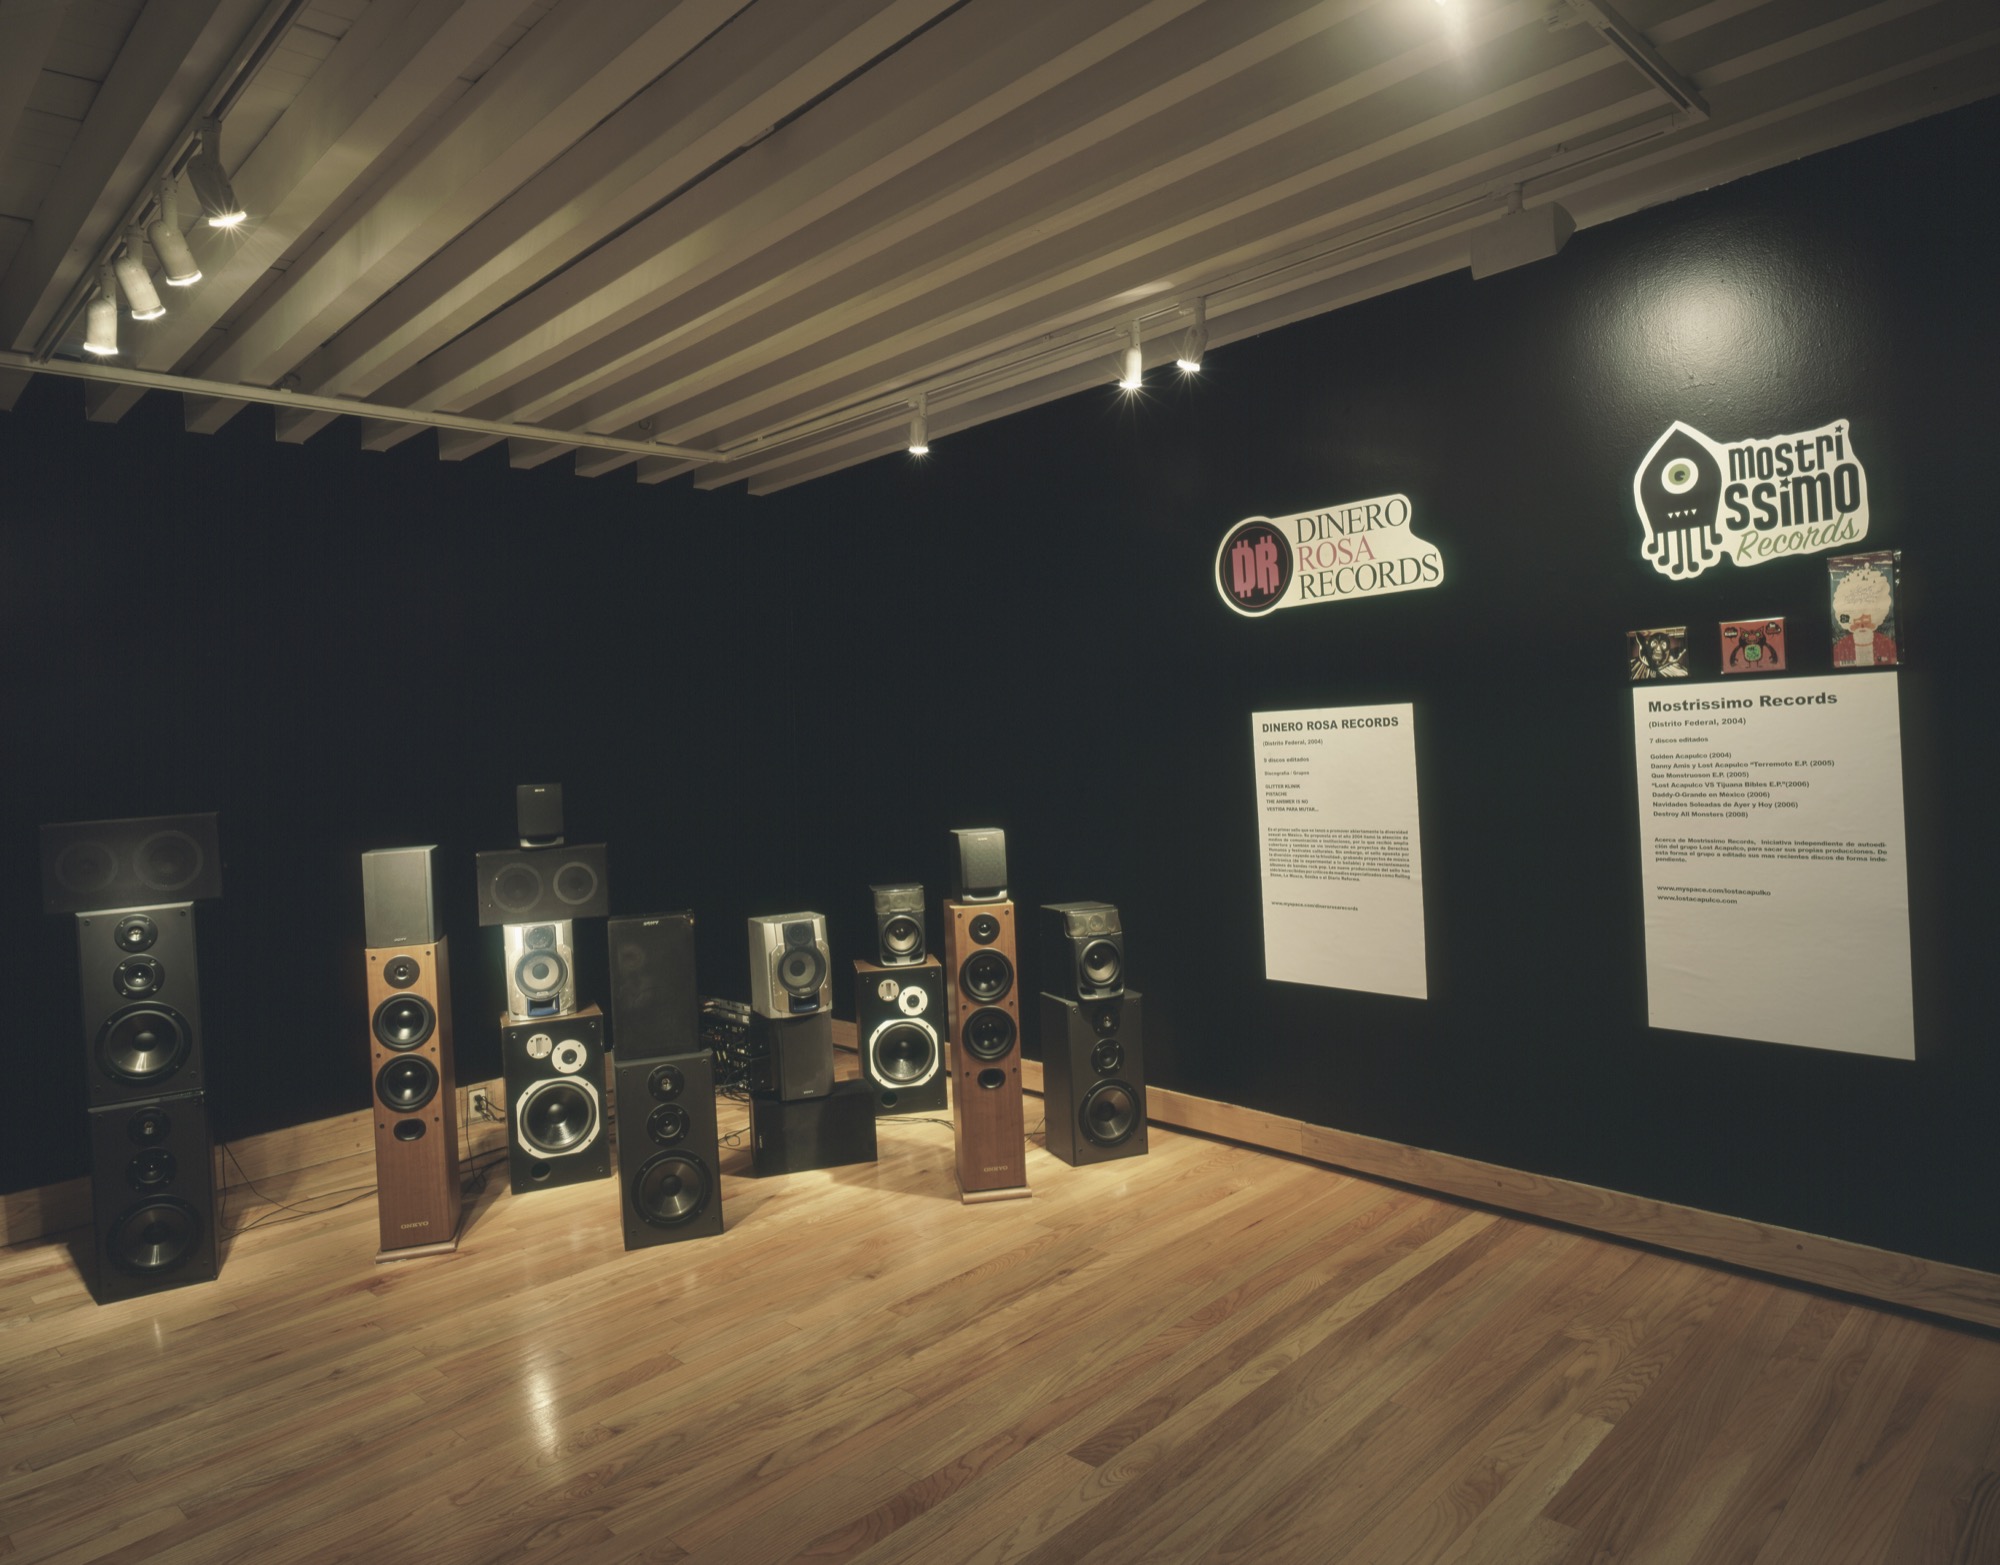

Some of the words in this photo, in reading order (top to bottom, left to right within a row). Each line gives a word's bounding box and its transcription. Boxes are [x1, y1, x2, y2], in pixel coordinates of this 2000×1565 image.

[1295, 498, 1408, 544] DINERO
[1736, 513, 1860, 562] Records
[1297, 534, 1376, 573] ROSA
[1298, 553, 1440, 600] RECORDS
[1648, 697, 1752, 712] Mostrissimo
[1759, 692, 1837, 706] Records
[1263, 721, 1303, 732] DINERO
[1306, 720, 1337, 730] ROSA
[1341, 716, 1398, 728] RECORDS
[1649, 720, 1682, 728] (Distrito
[1684, 718, 1719, 726] Federal,
[1721, 717, 1746, 725] 2004)
[1809, 759, 1835, 767] (2005)
[1653, 810, 1679, 818] Destroy
[400, 1220, 429, 1229] ONKYO
